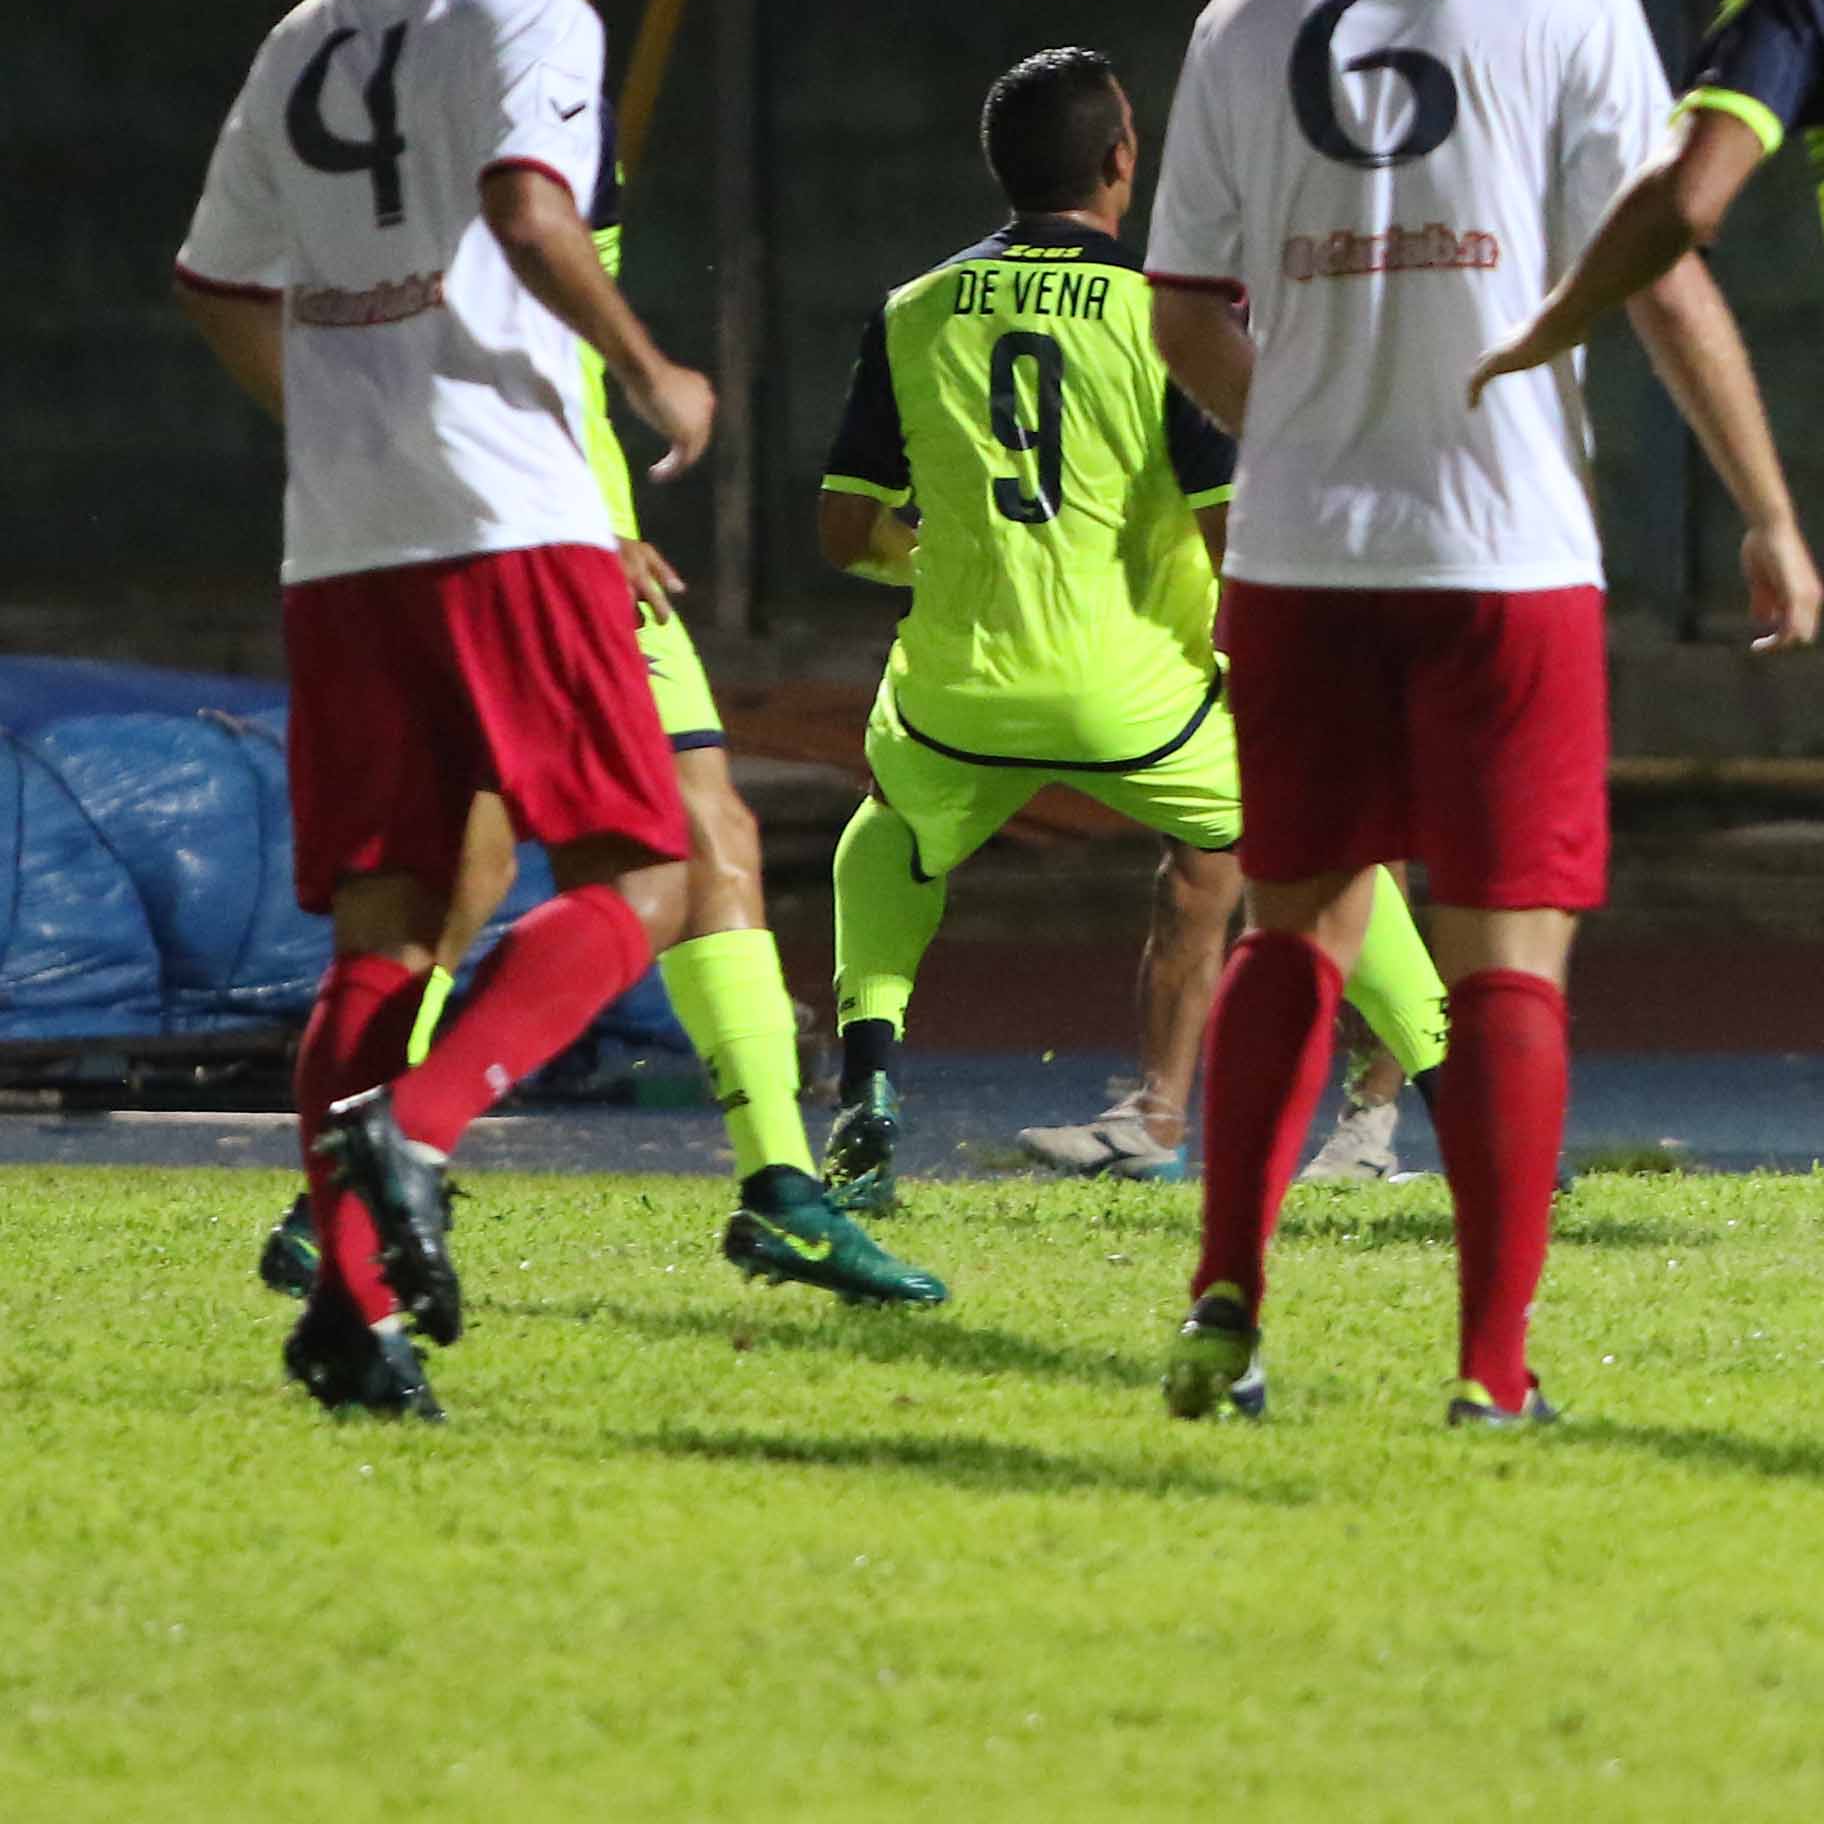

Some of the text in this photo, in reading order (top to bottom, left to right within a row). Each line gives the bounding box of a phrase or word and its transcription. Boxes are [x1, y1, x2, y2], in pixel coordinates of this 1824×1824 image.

[285, 19, 408, 227] 4
[953, 269, 1110, 320] DE VENA
[989, 331, 1064, 524] 9
